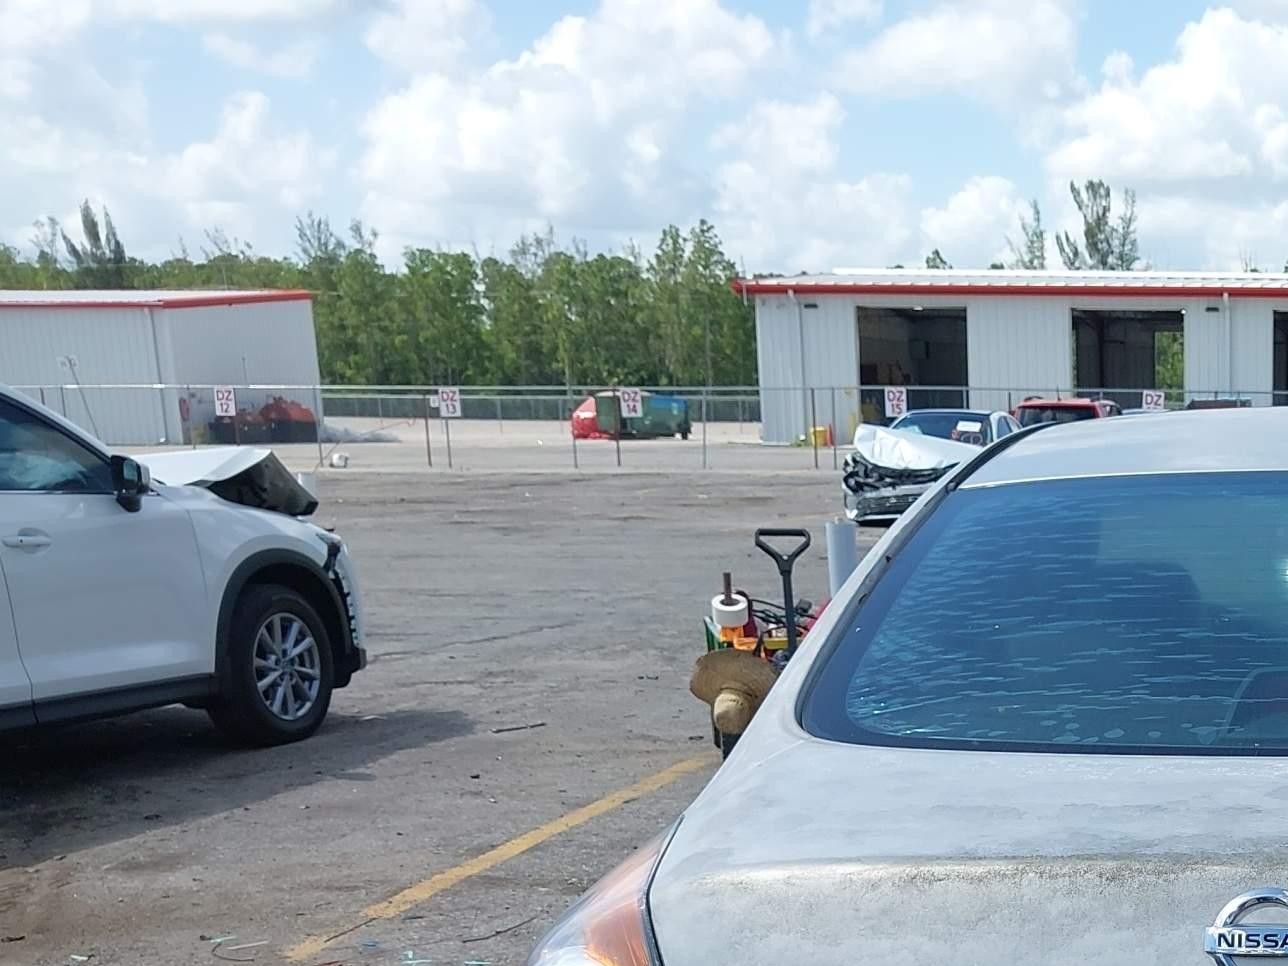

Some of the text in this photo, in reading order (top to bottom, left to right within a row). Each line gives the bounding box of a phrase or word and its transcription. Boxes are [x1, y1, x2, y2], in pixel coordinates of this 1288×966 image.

[216, 390, 232, 401] DZ
[441, 391, 457, 402] DZ
[622, 391, 639, 402] DZ
[887, 390, 904, 402] DZ
[1145, 394, 1162, 406] DZ
[220, 402, 229, 413] 12
[446, 403, 457, 414] 13
[627, 403, 637, 414] 14
[891, 403, 902, 415] 15
